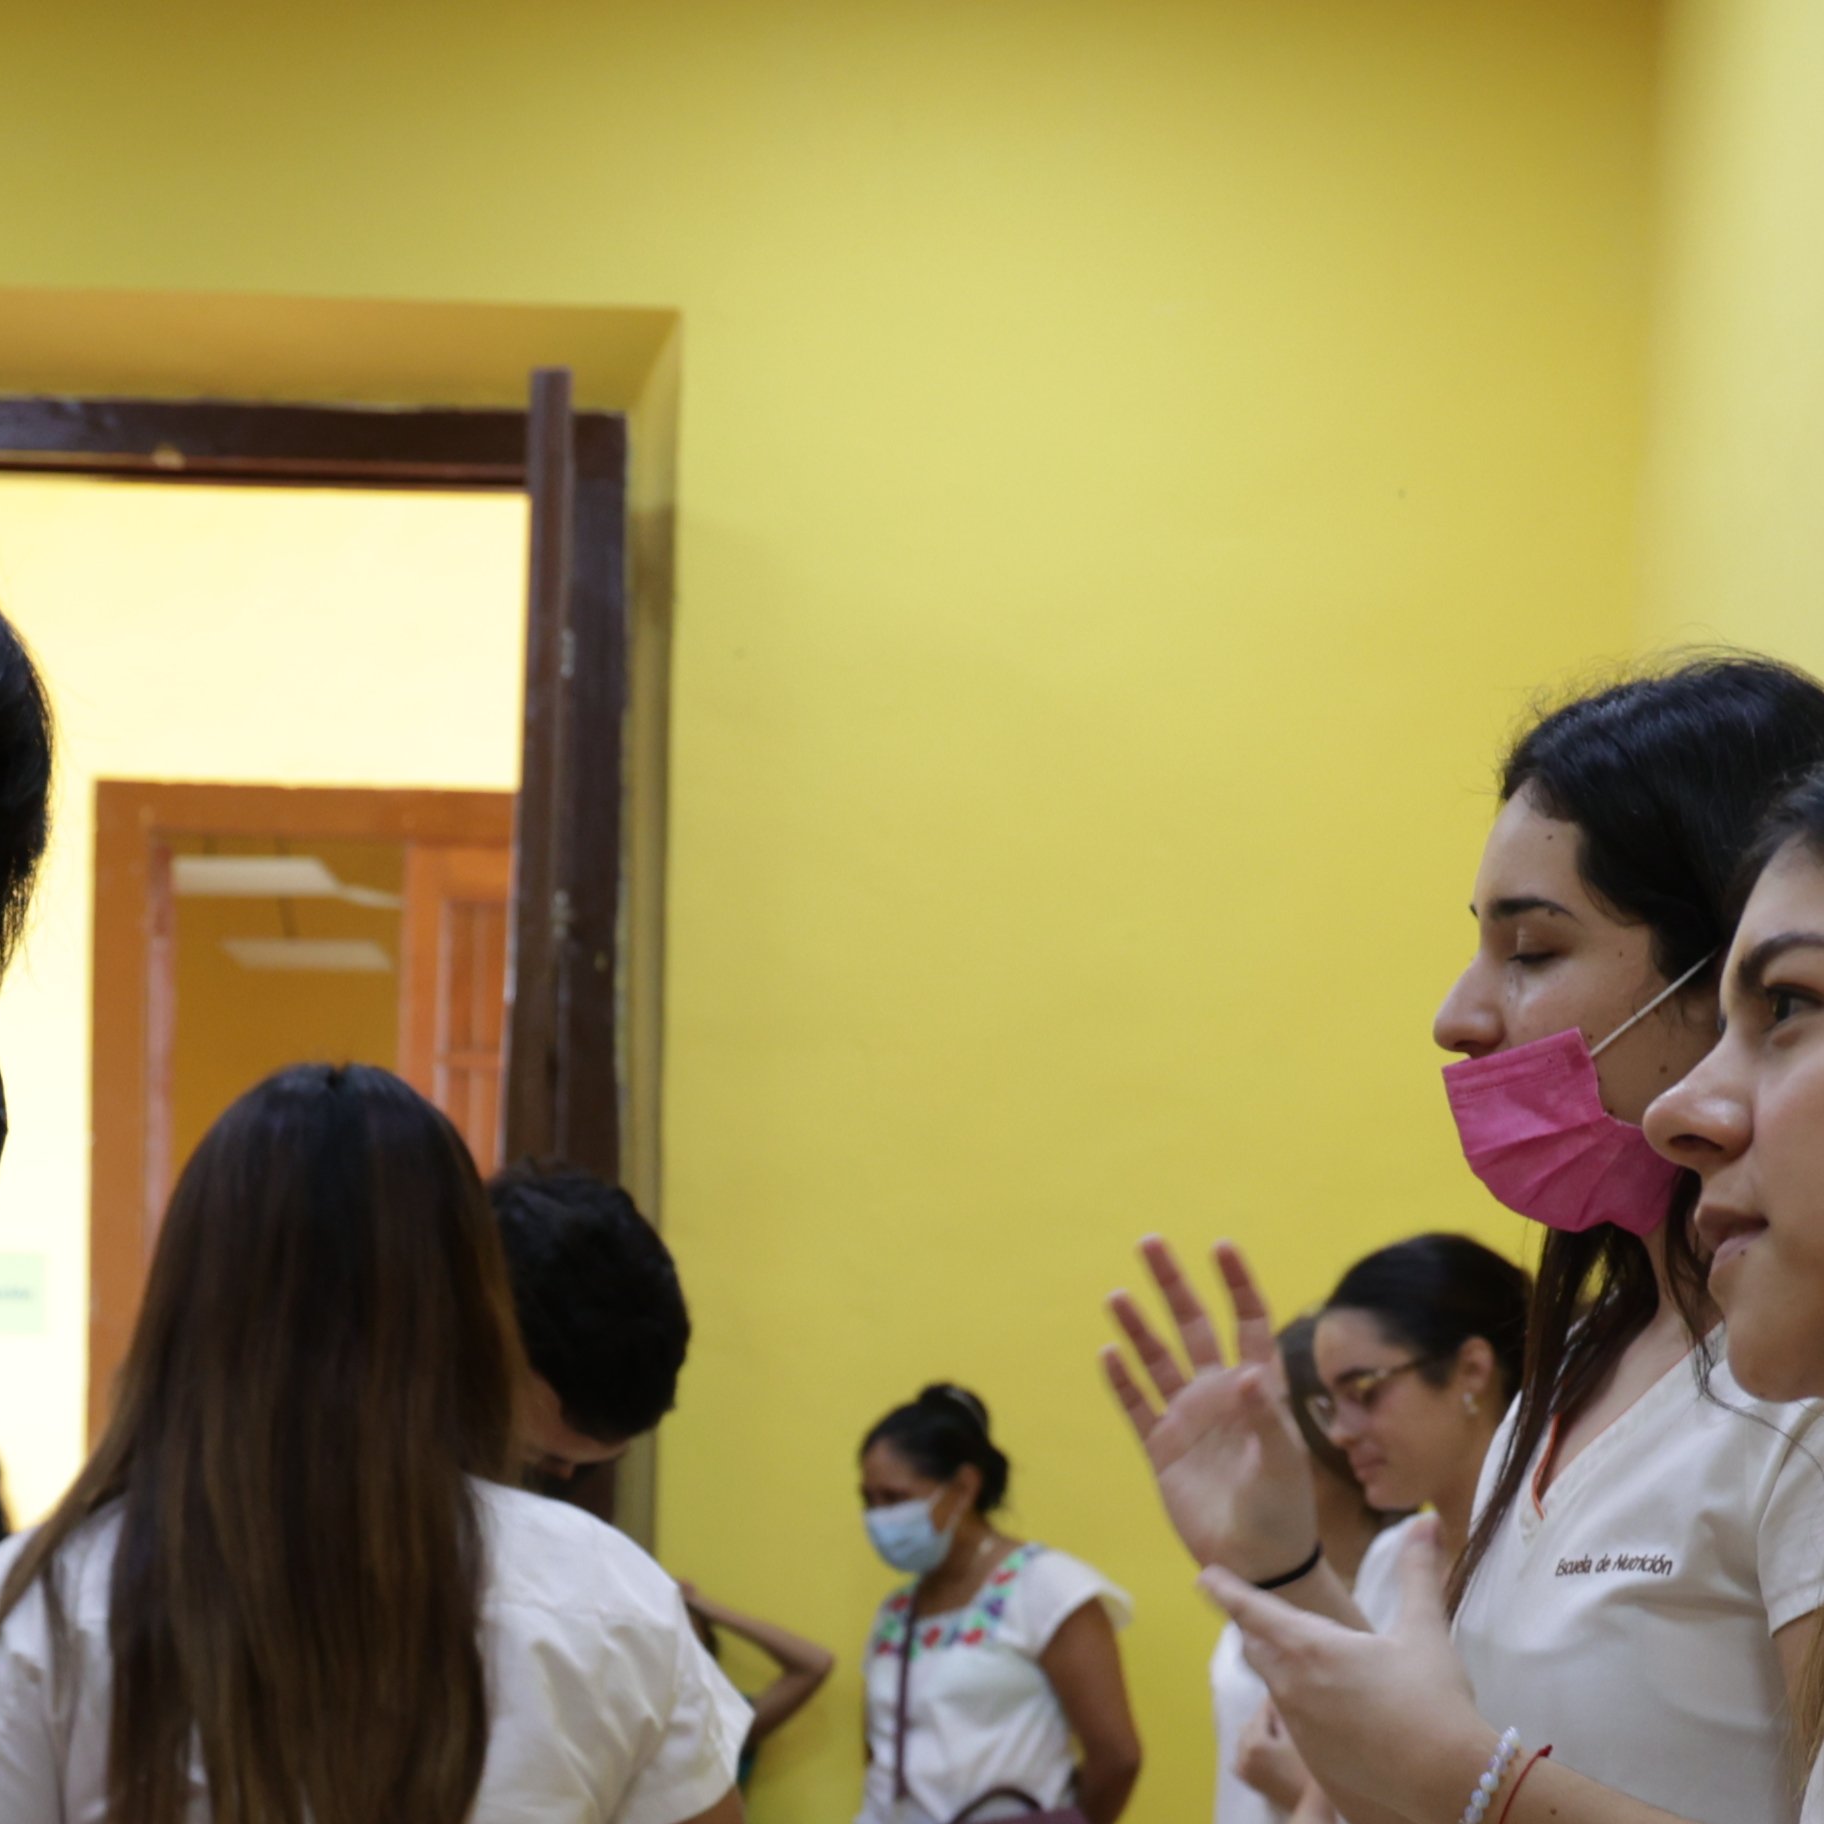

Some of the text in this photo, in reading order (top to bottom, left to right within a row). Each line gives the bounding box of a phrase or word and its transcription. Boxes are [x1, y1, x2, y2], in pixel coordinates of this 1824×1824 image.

[1555, 1552, 1674, 1577] Escuela de Nutrición
